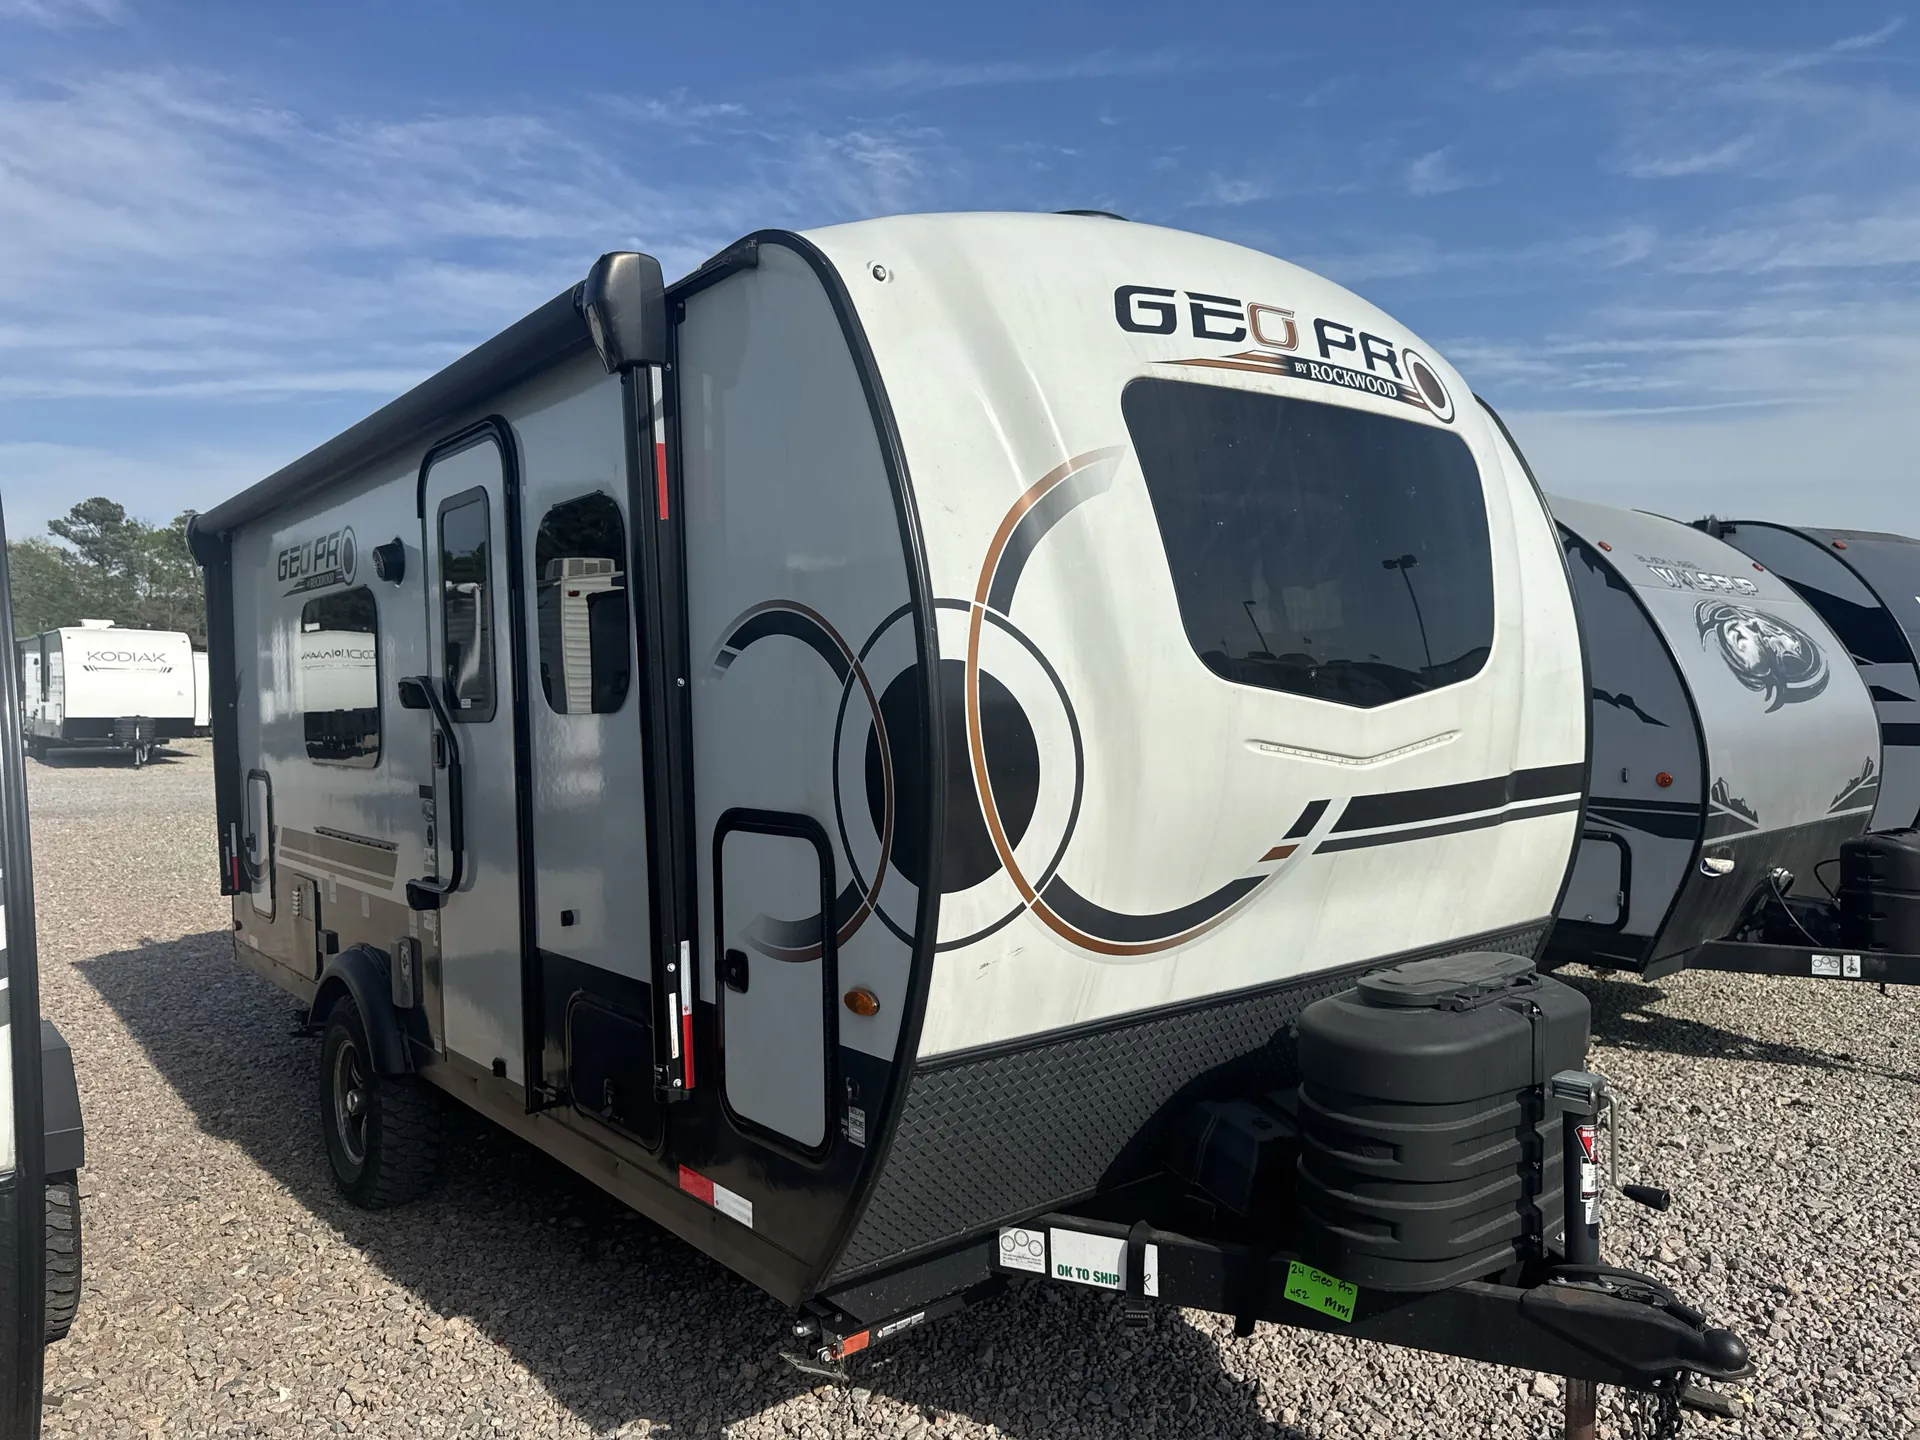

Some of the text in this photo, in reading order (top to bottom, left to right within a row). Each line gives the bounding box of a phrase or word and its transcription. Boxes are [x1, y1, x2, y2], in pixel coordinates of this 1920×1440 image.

[1114, 284, 1455, 425] GEO PRO
[1294, 361, 1399, 399] BY ROCKWOOD
[277, 525, 358, 587] GEO PRO
[87, 650, 167, 663] KODIAK
[1057, 1263, 1120, 1286] OK TO SHIP
[1290, 1263, 1354, 1296] 24 Geo Pro
[1290, 1287, 1310, 1300] 452
